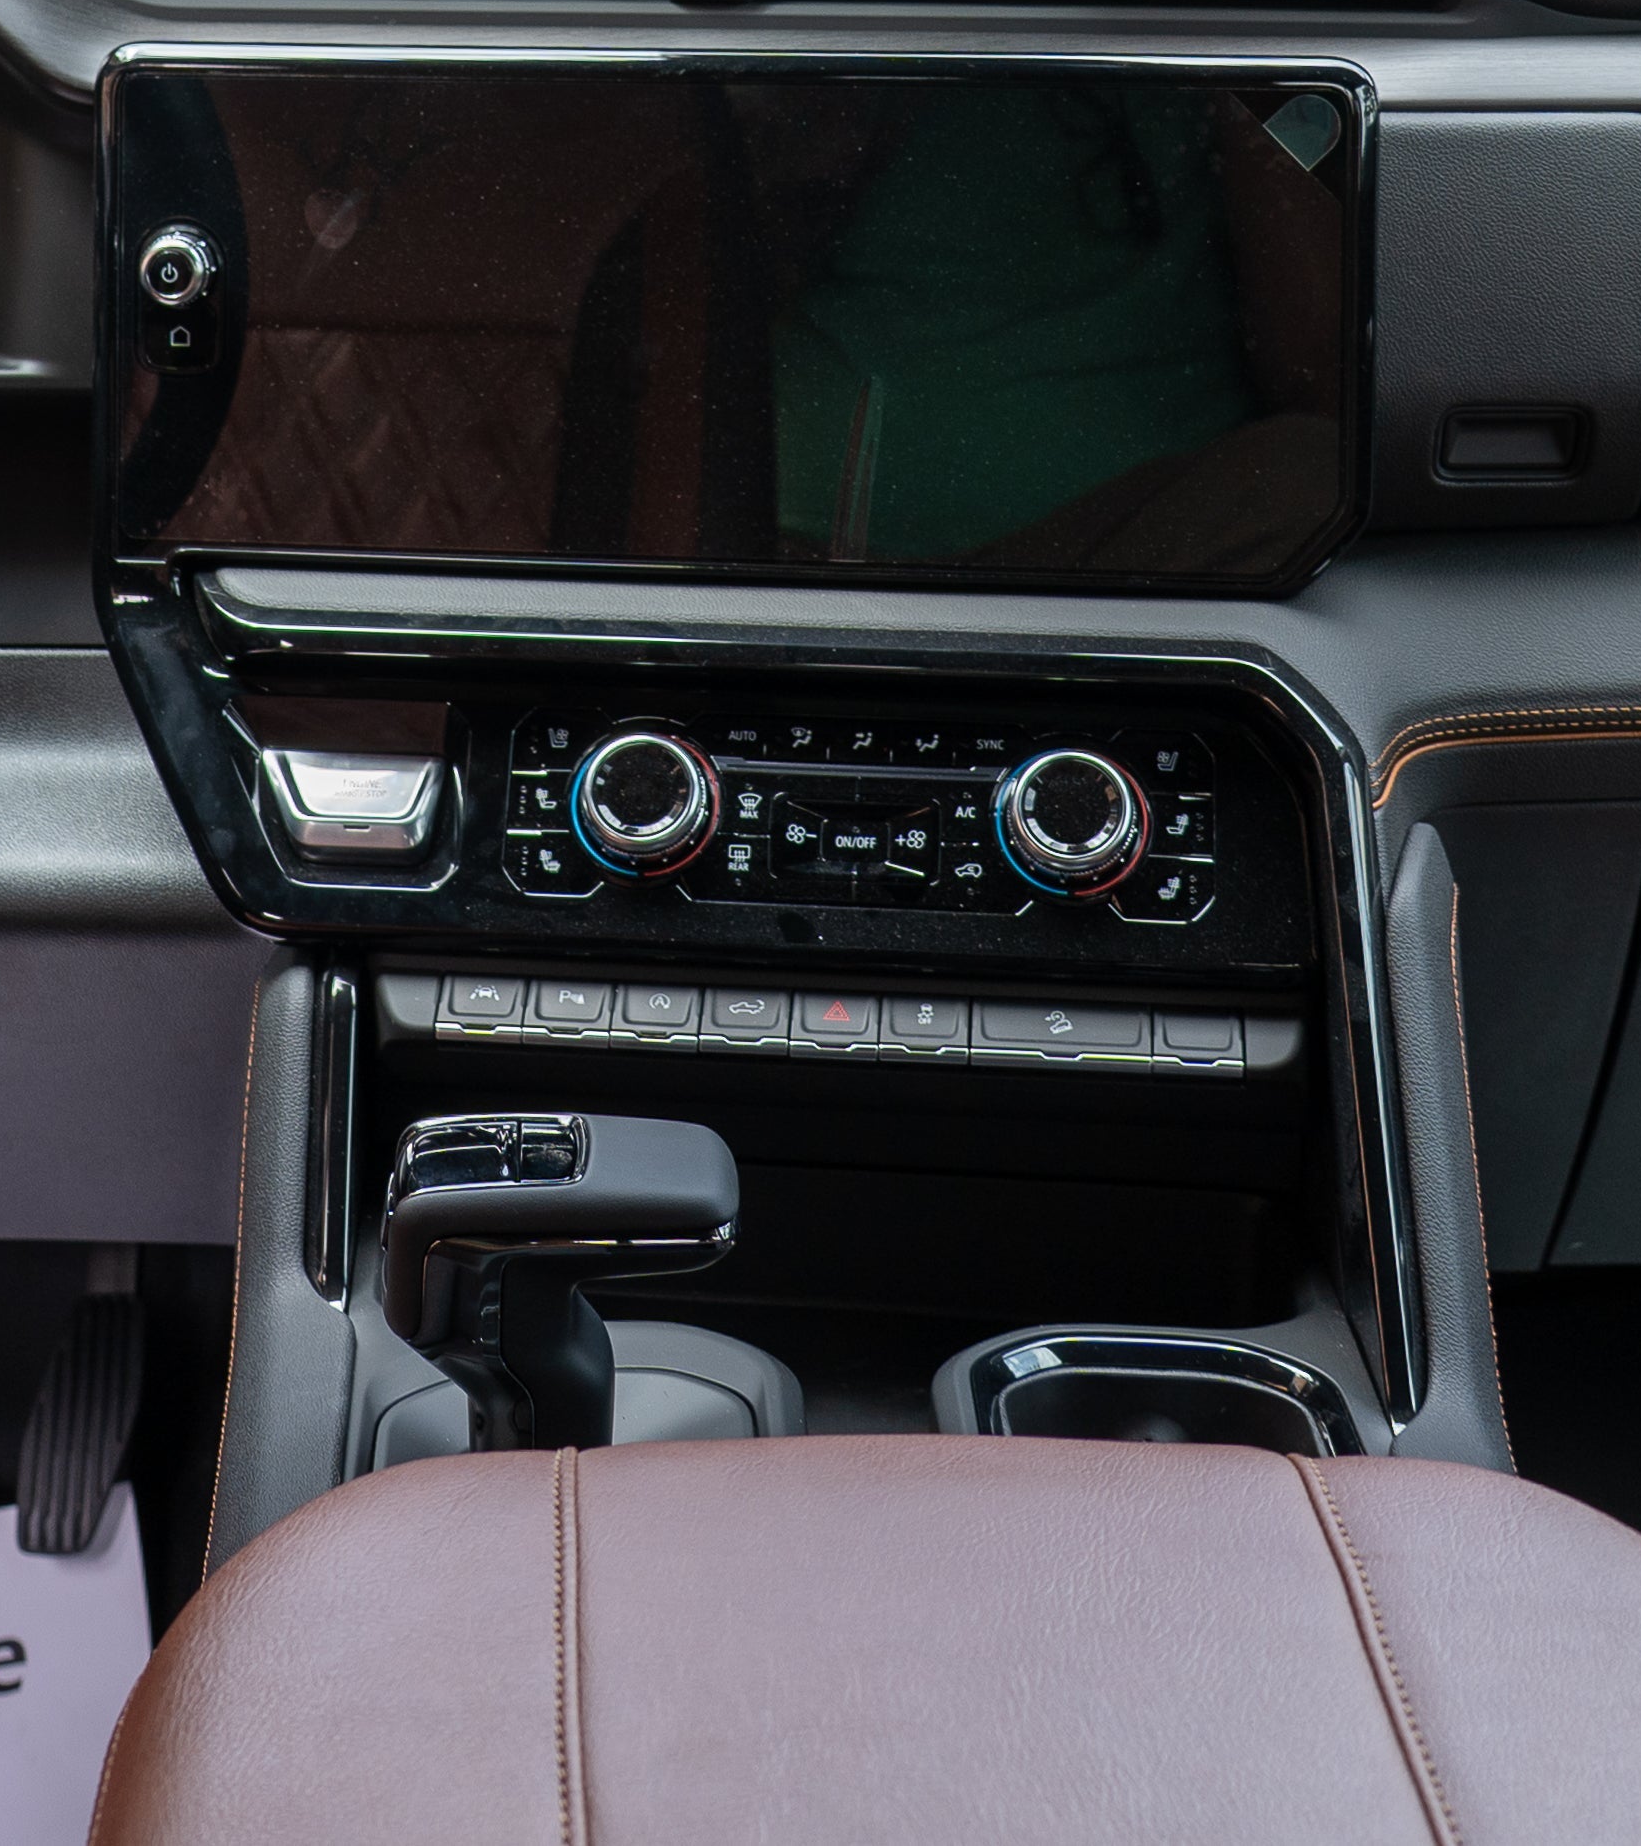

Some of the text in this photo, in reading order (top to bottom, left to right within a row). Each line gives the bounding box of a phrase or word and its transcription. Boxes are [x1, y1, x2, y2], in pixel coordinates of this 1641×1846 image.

[728, 730, 757, 742] AUTO
[976, 739, 1005, 750] SYNC
[739, 810, 759, 819] MAX
[955, 806, 976, 818] A/C
[835, 836, 877, 849] ON/OFF
[728, 862, 750, 872] REAR
